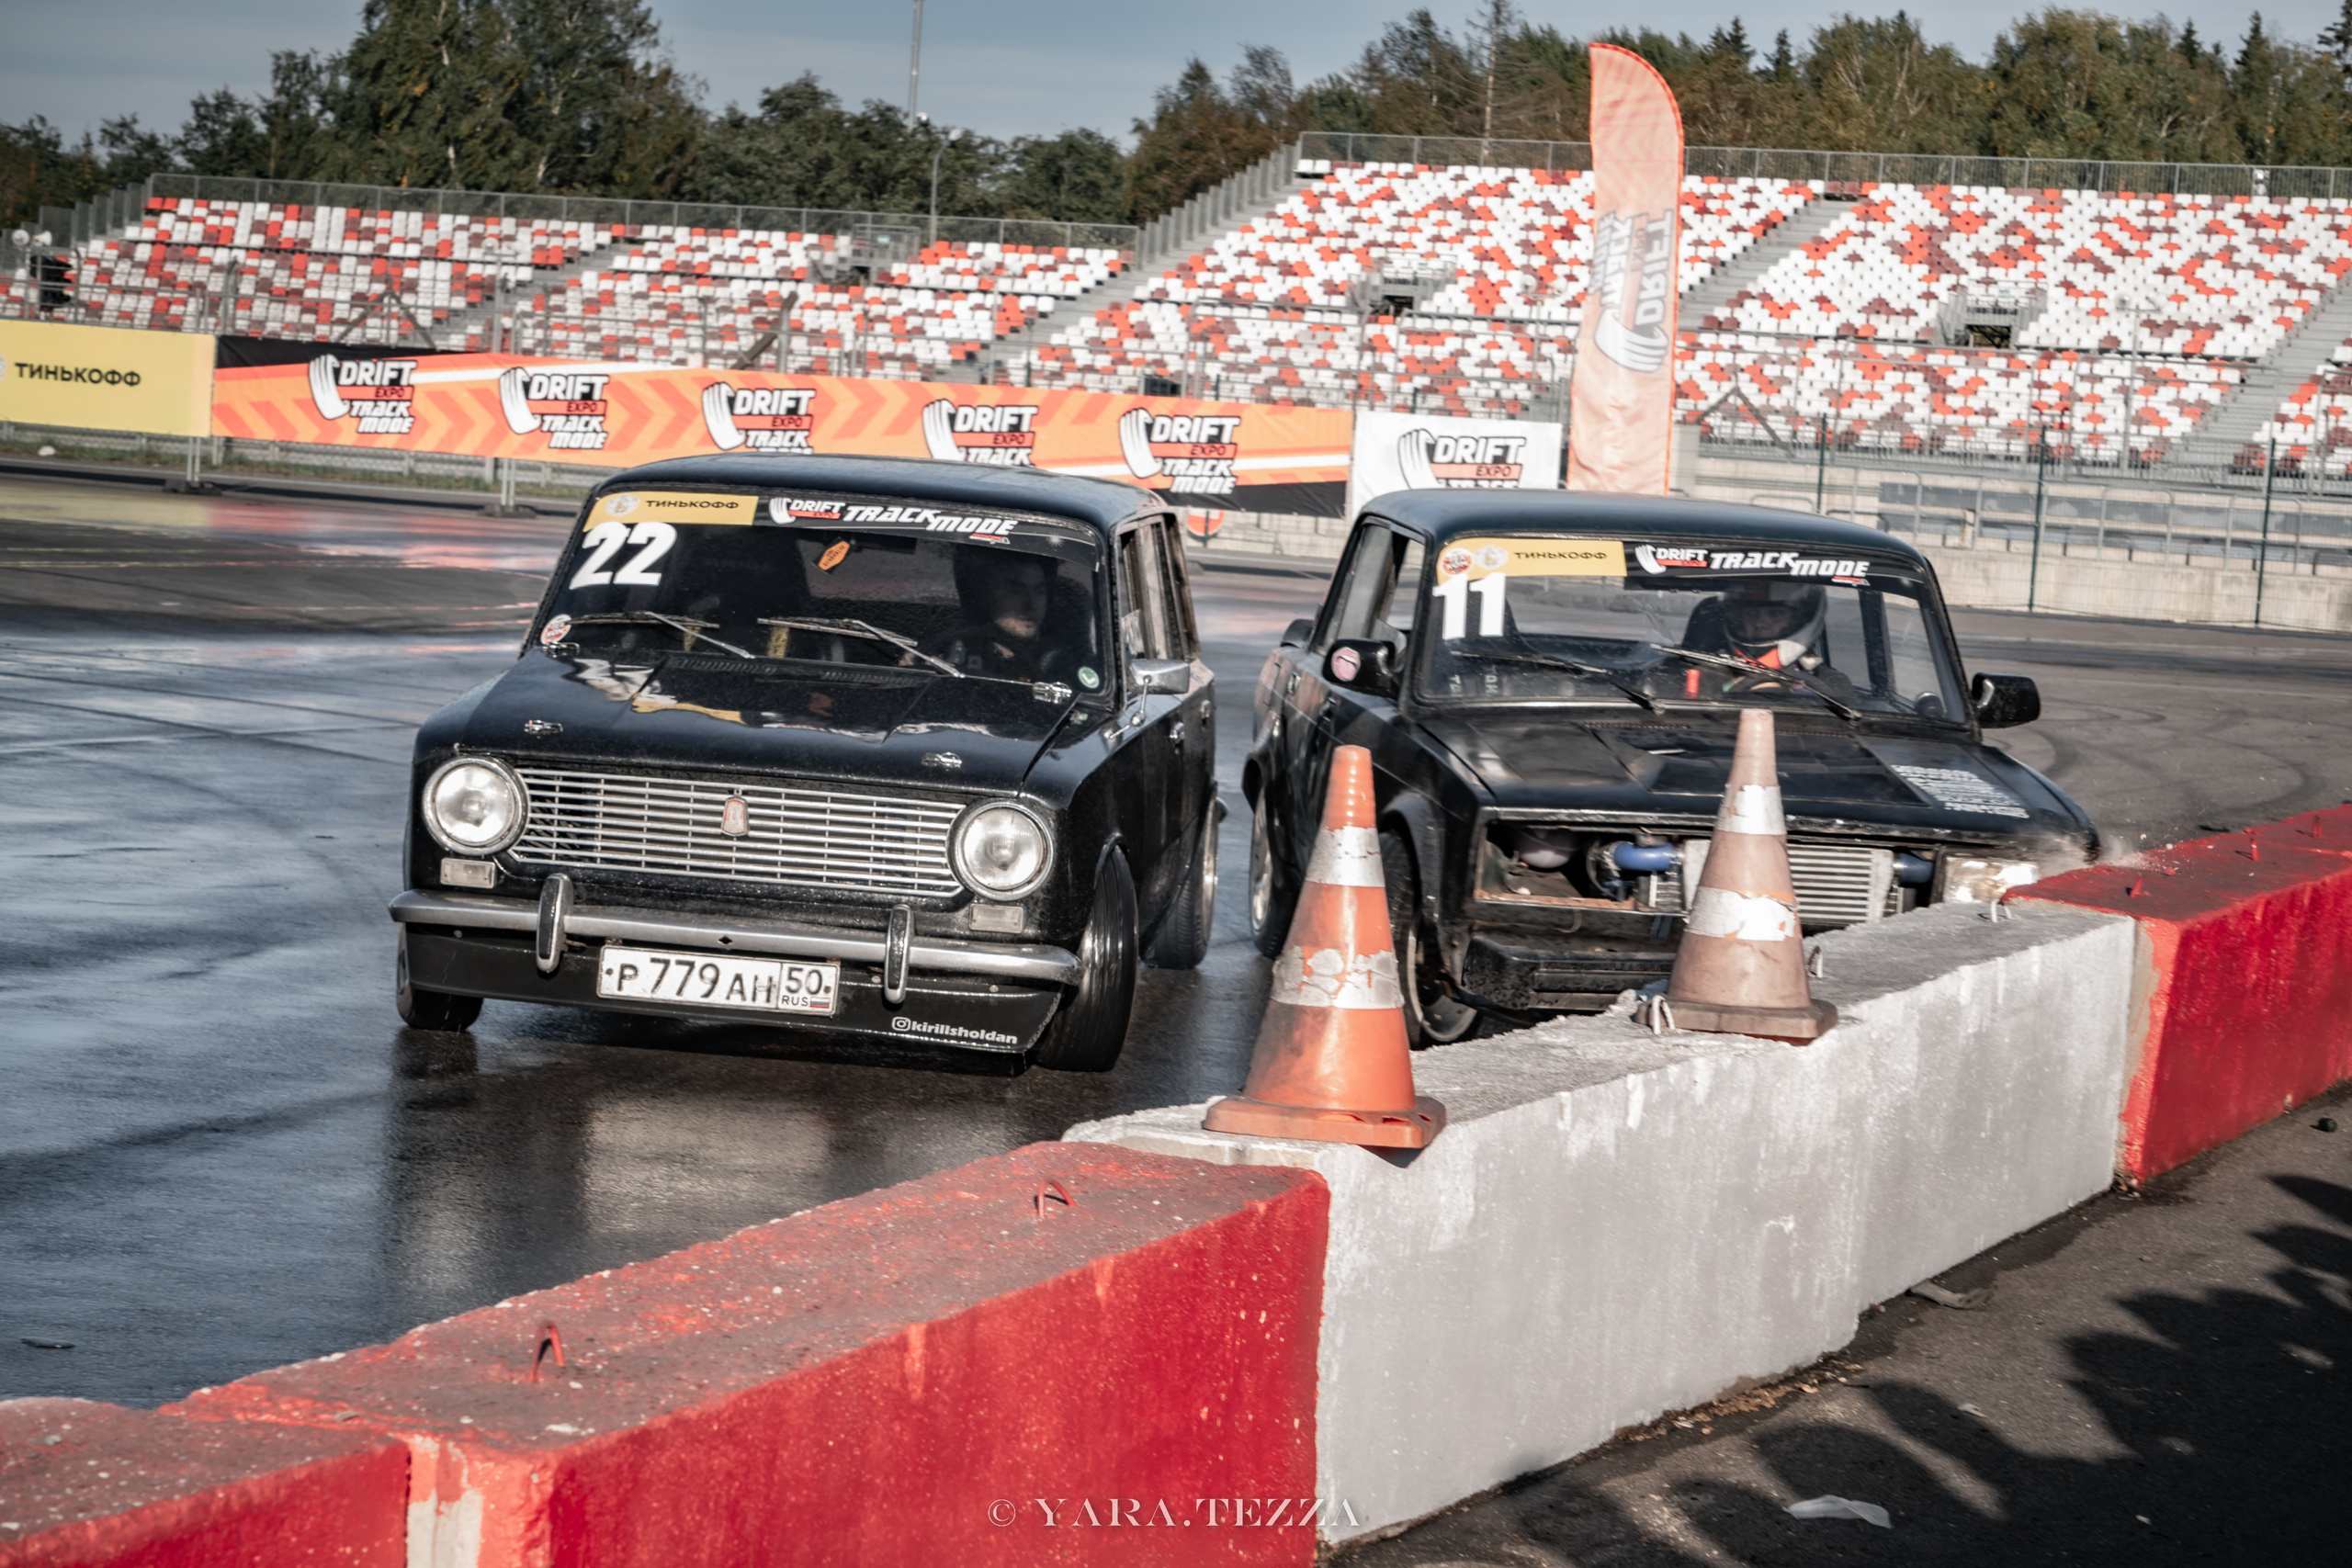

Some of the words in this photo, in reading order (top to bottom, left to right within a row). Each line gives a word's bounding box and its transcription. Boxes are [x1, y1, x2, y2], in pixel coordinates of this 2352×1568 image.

[14, 362, 141, 387] ТИНЬКОФФ
[337, 360, 418, 386] DRIFT
[375, 388, 404, 398] EXPO
[528, 374, 610, 400] DRIFT
[567, 401, 597, 412] EXPO
[732, 389, 816, 415] DRIFT
[772, 417, 803, 427] EXPO
[954, 405, 1039, 433] DRIFT
[1150, 415, 1241, 444] DRIFT
[993, 434, 1025, 445] EXPO
[1191, 446, 1227, 456] EXPO
[1433, 436, 1526, 464] DRIFT
[1476, 466, 1511, 477] EXPO
[646, 500, 739, 509] ТИНЬКОФФ
[788, 500, 846, 513] DRIFT
[569, 521, 677, 590] 22
[1514, 551, 1608, 559] ТИНЬКОФФ
[1655, 547, 1709, 561] DRIFT
[1432, 572, 1506, 640] 11
[785, 966, 823, 995] 50
[782, 995, 808, 1007] RUS
[910, 1021, 1018, 1044] kirillsholdan
